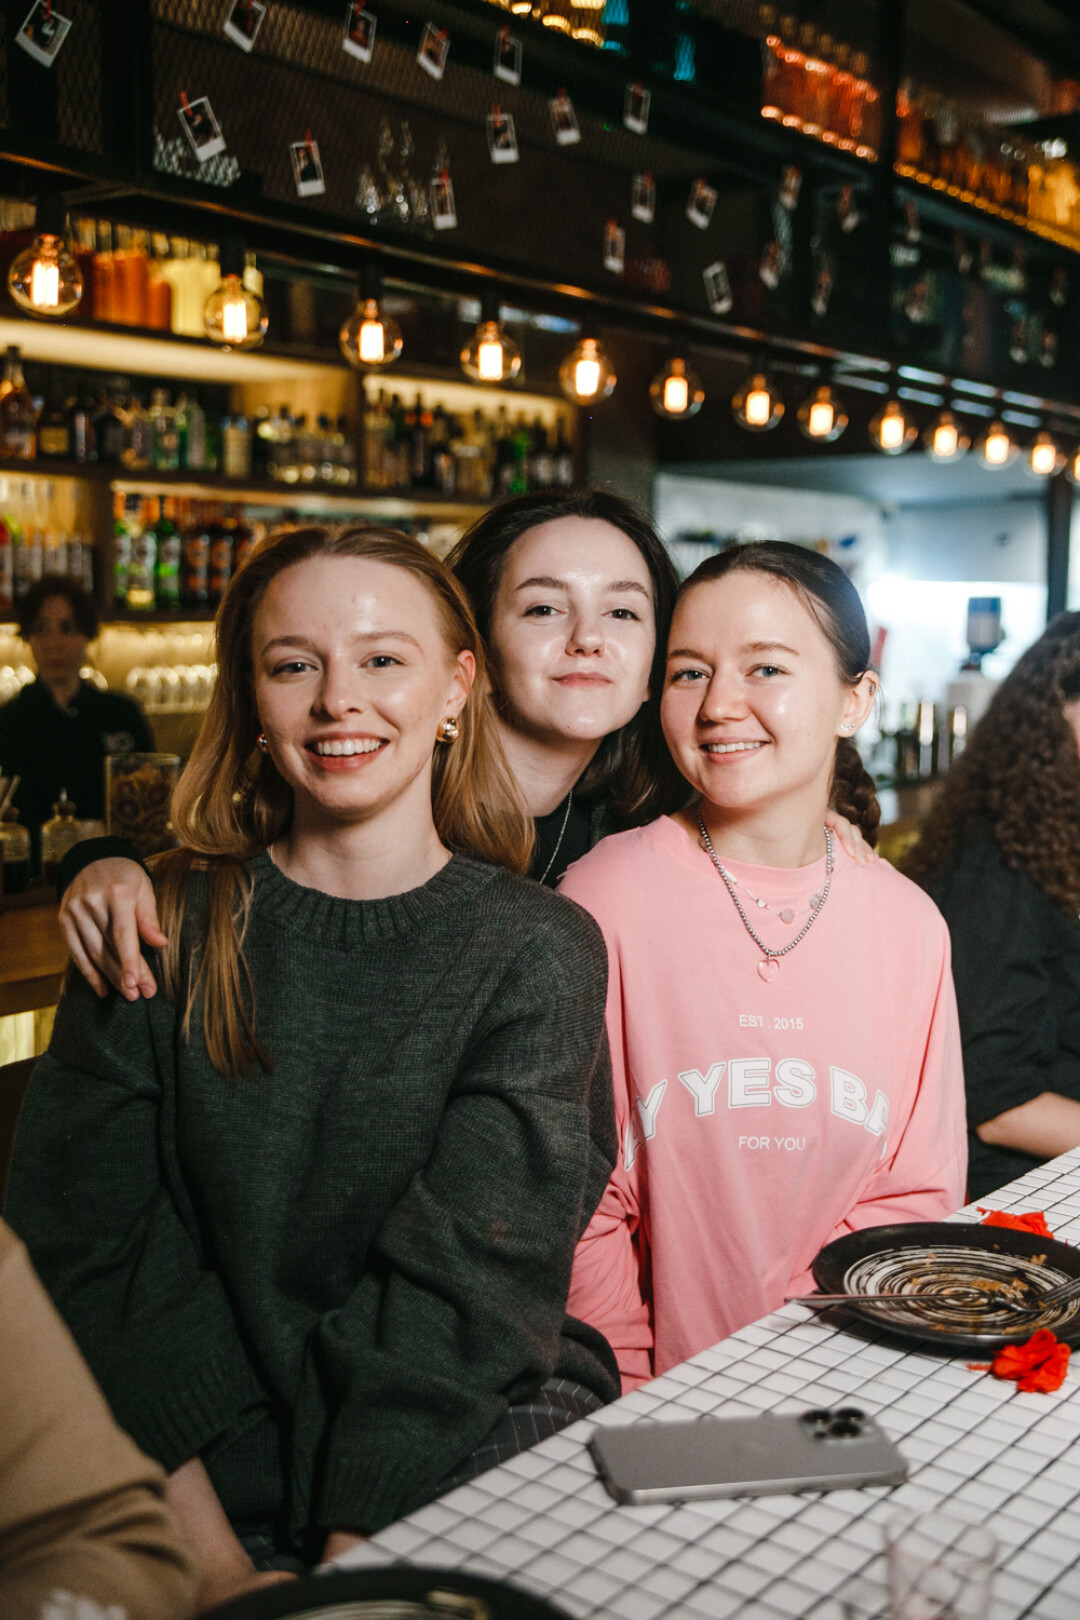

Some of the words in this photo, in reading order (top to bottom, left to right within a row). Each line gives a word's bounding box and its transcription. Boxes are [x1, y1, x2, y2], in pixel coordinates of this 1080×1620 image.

[773, 1017, 805, 1030] 2015
[677, 1057, 817, 1118] YES
[738, 1136, 770, 1150] FOR
[774, 1137, 806, 1151] YOU
